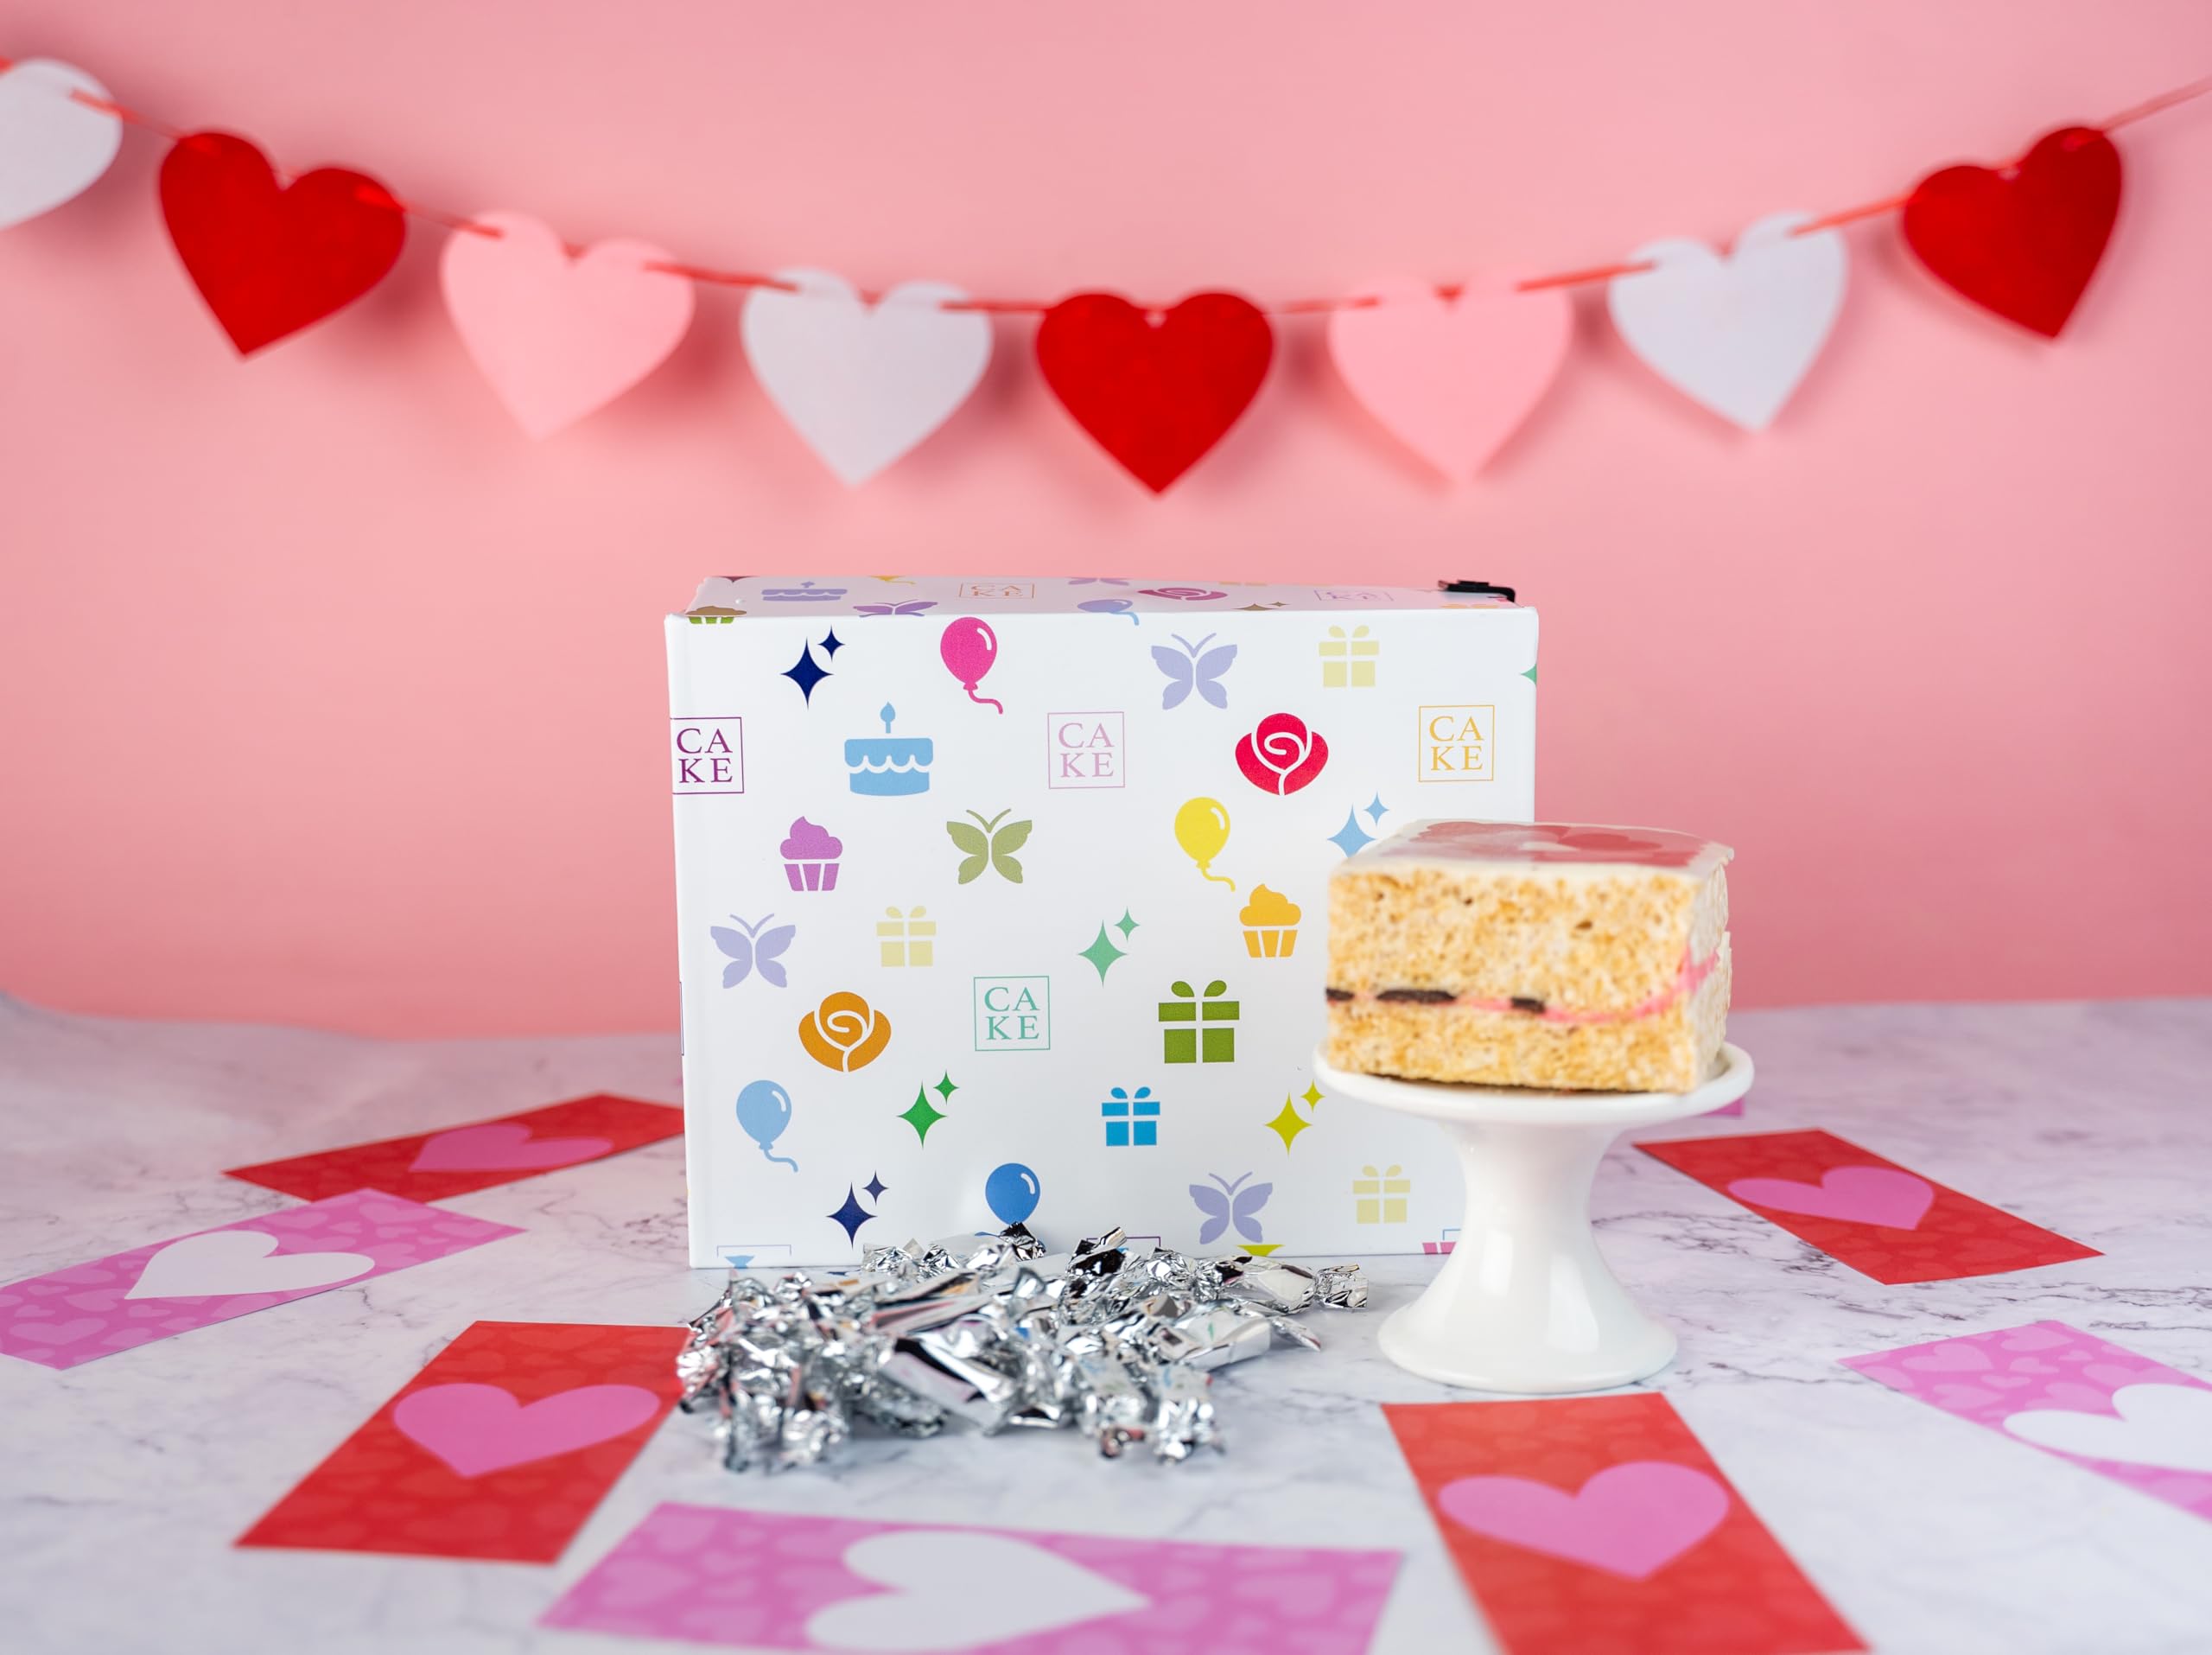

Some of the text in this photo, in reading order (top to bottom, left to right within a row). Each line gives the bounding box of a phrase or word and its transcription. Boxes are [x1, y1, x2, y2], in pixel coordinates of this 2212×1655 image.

[677, 728, 733, 754] CA
[1058, 722, 1115, 748] CA
[1429, 716, 1484, 742] CA
[677, 758, 733, 783] KE
[1060, 753, 1113, 778] KE
[1431, 745, 1483, 772] KE
[984, 987, 1040, 1012] CA
[986, 1015, 1039, 1040] KE
